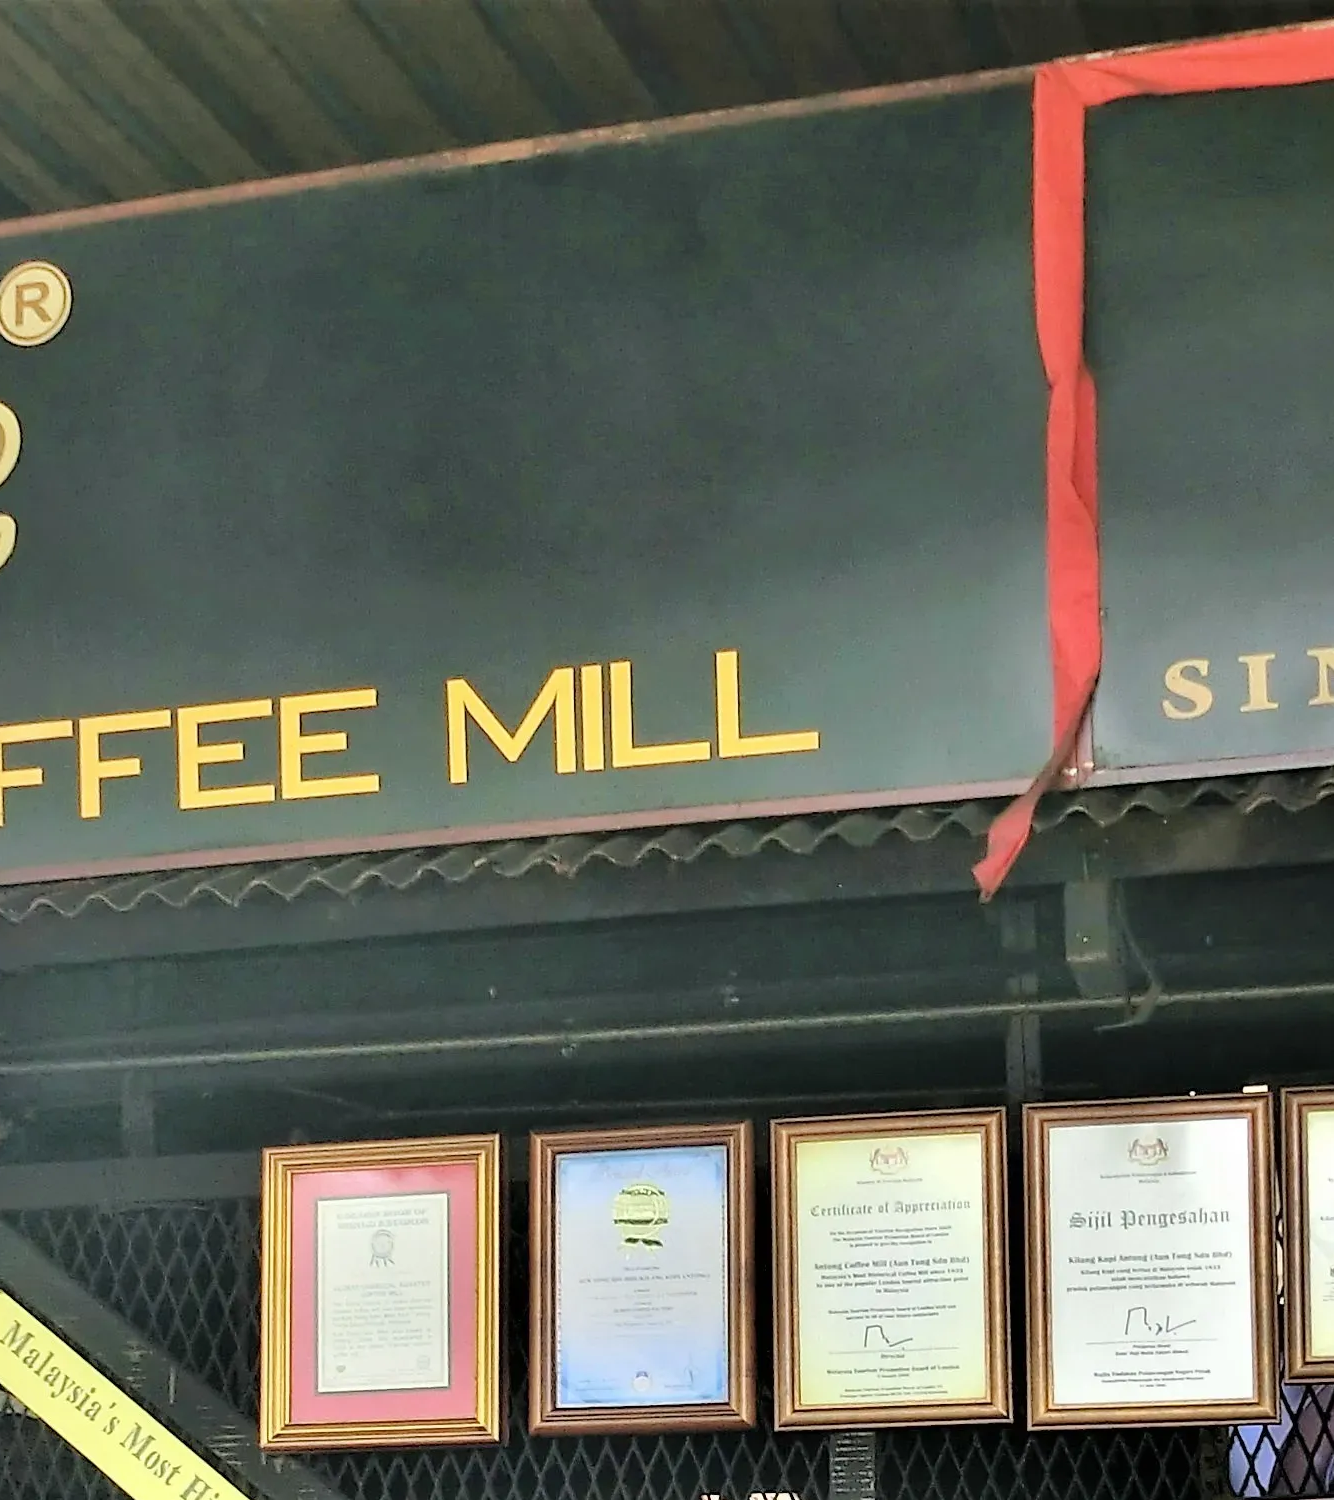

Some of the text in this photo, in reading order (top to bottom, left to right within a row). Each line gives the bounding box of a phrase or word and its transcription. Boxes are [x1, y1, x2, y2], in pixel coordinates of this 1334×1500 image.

[446, 648, 820, 784] MILL
[810, 1199, 971, 1218] Certificate of Appreciation
[1069, 1207, 1230, 1231] Sijil Pengesahan
[119, 1422, 183, 1487] Most
